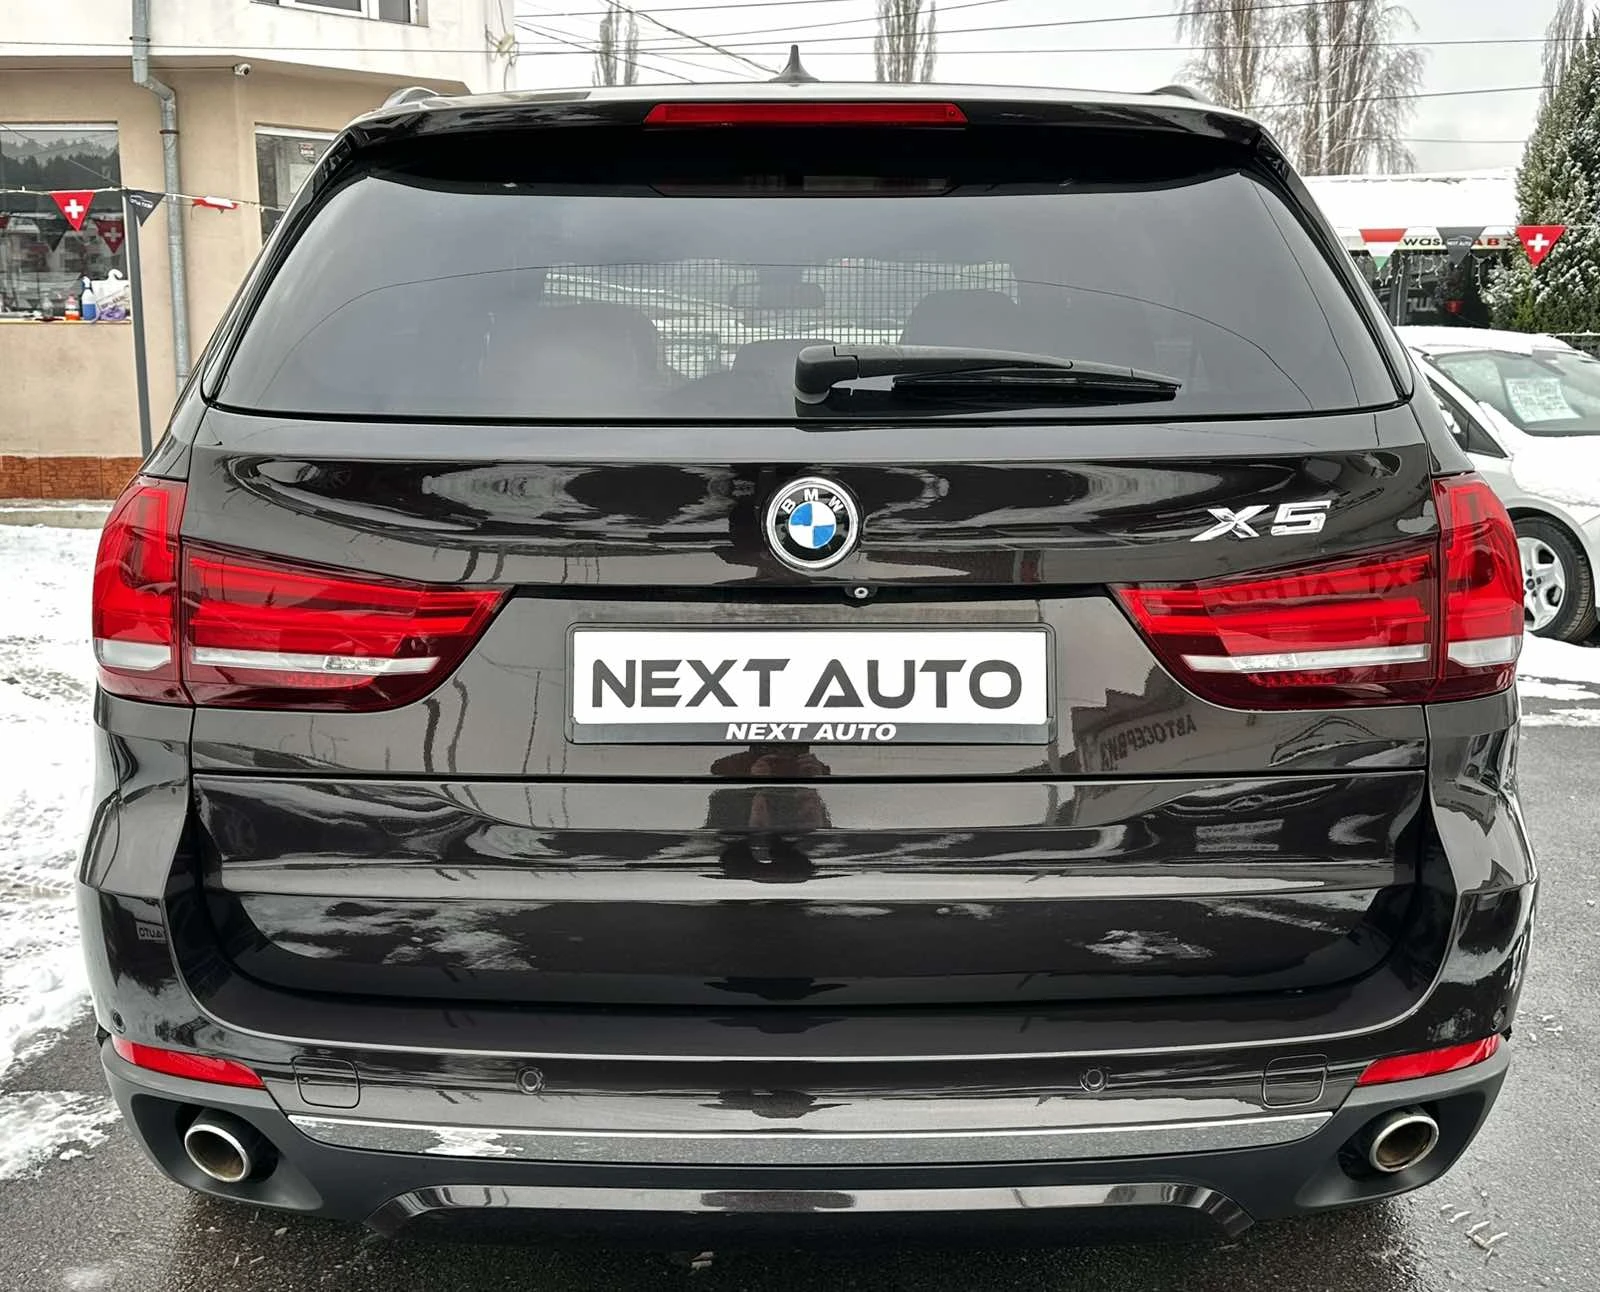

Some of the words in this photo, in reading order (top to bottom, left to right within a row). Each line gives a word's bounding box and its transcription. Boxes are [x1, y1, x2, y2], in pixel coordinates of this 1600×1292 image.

[1403, 238, 1444, 246] was
[781, 488, 844, 514] BMW
[1190, 500, 1331, 542] X5
[592, 658, 790, 708] NEXT
[804, 658, 1022, 709] AUTO
[725, 723, 806, 740] NEXT
[813, 723, 897, 740] AUTO
